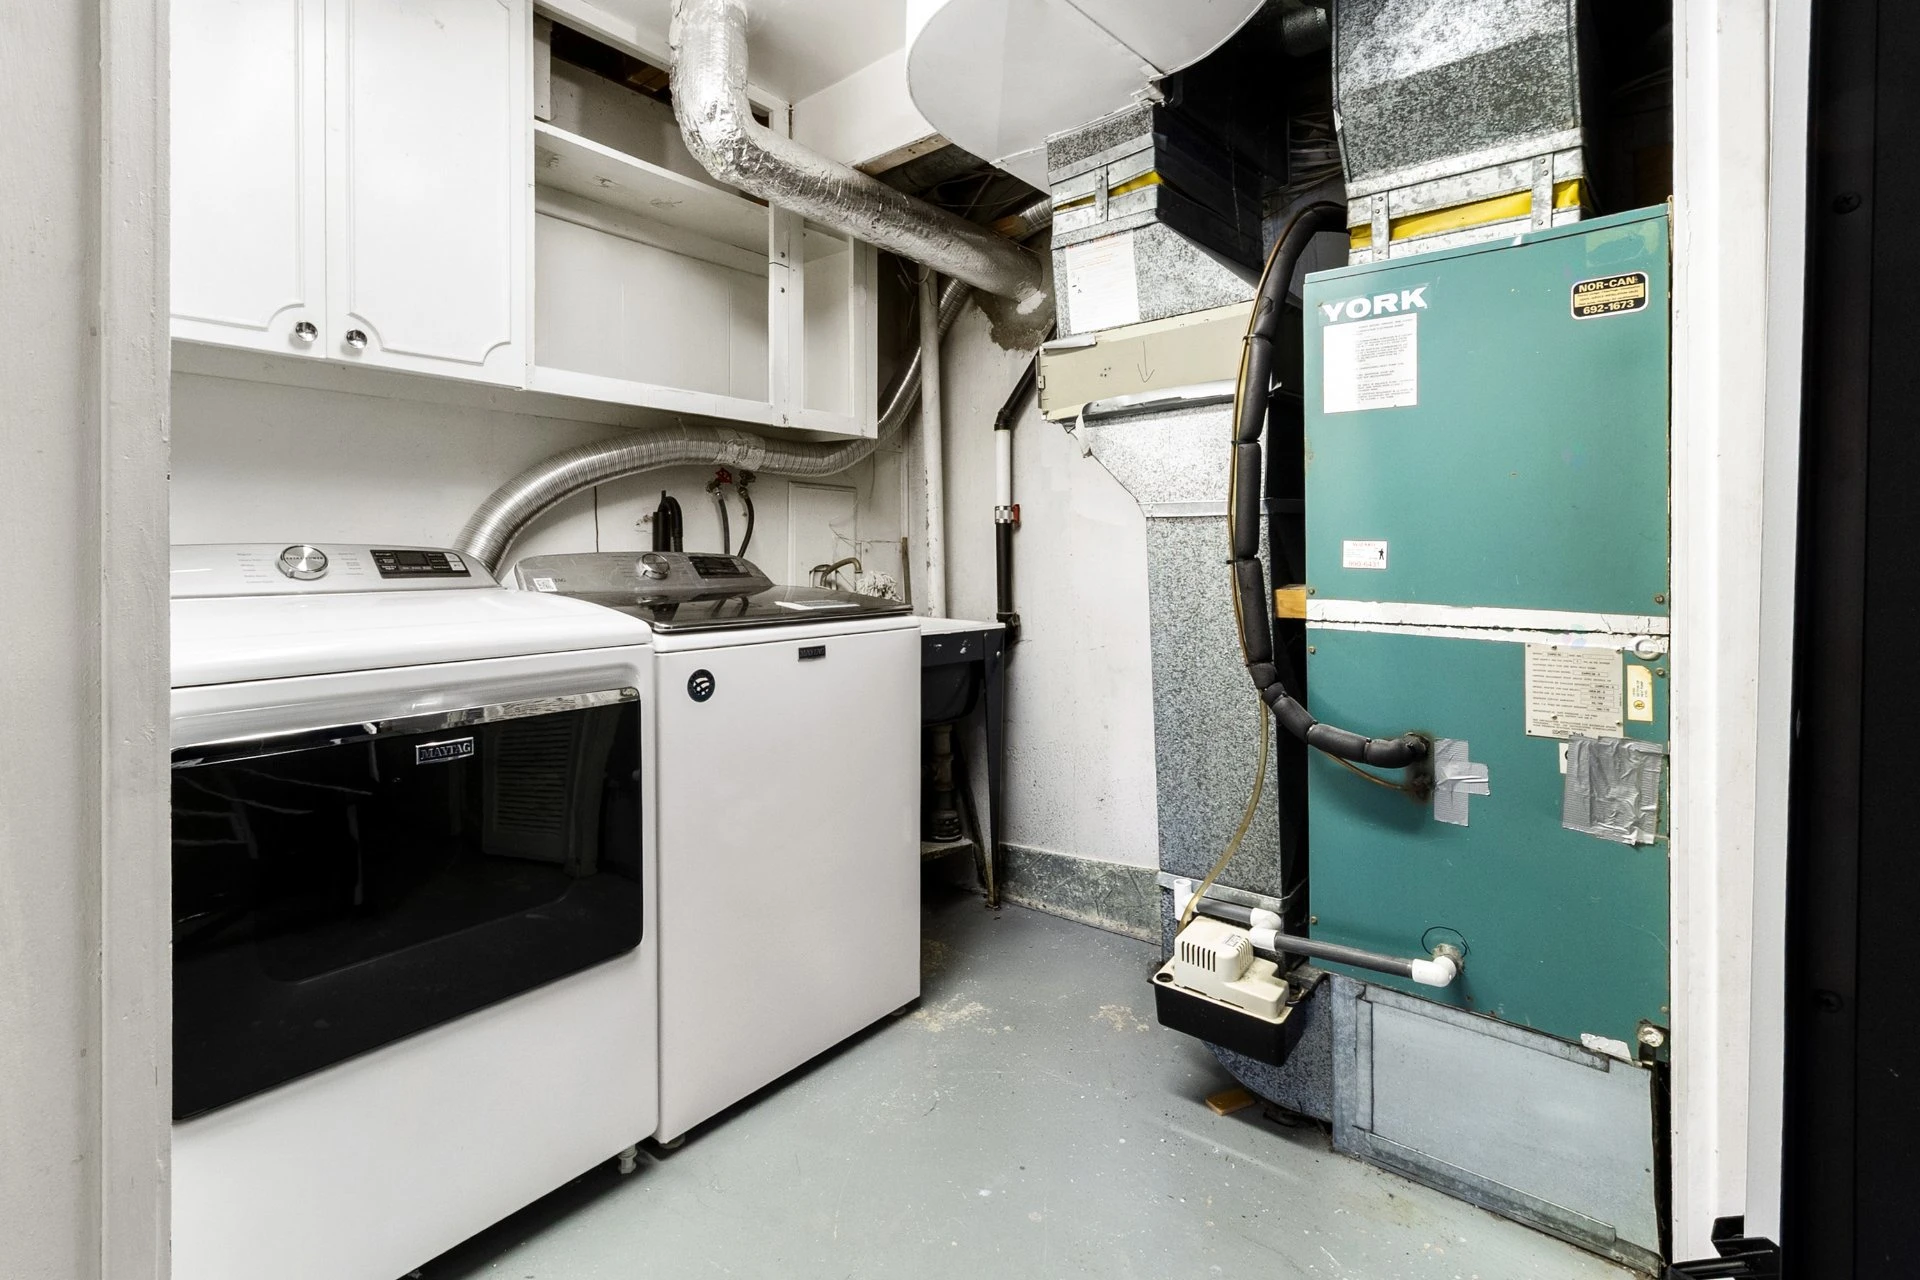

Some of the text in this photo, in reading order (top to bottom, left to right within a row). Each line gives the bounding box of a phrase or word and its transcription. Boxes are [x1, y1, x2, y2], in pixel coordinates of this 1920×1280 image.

[1578, 275, 1635, 293] NOR-CAN
[1322, 286, 1427, 322] YORK
[1583, 299, 1635, 315] 692-1673
[420, 742, 471, 760] MAYTAG
